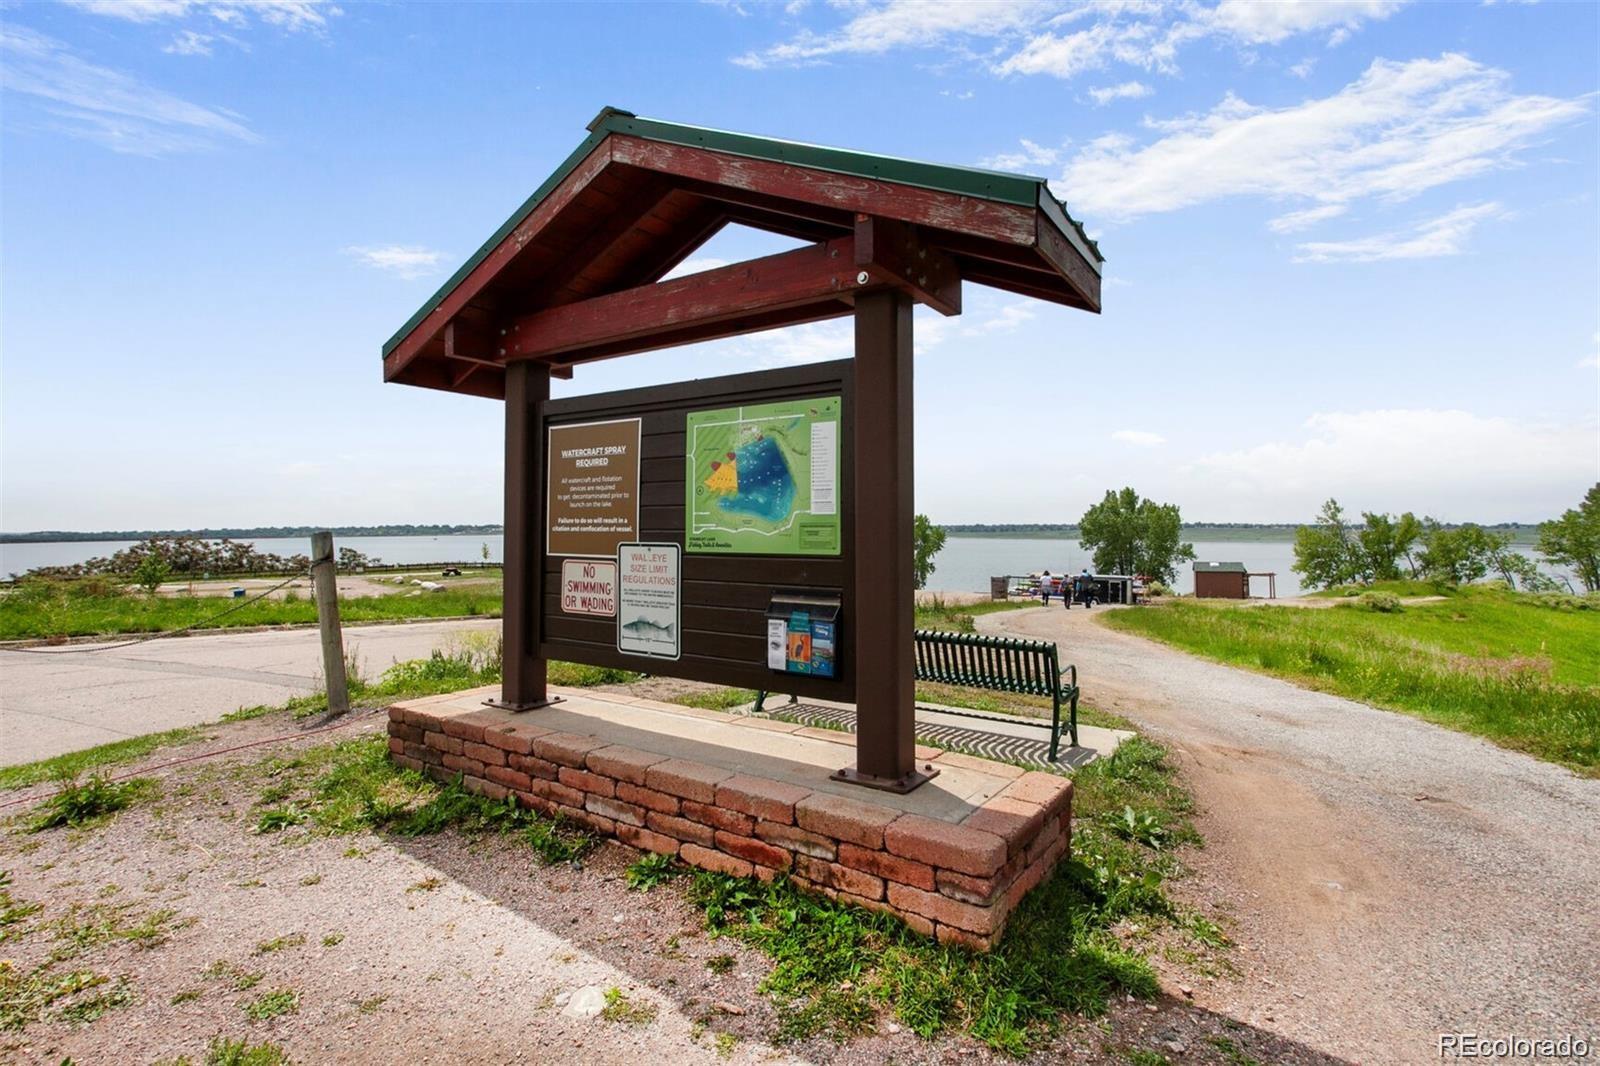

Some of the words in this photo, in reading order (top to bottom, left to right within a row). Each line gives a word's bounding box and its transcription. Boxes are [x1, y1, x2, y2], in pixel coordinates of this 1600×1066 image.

[561, 448, 604, 458] WATERCRAFT
[604, 445, 627, 456] SPRAY
[576, 458, 609, 468] REQUIRED
[583, 566, 596, 578] NO
[630, 564, 647, 574] SIZE
[649, 565, 668, 574] LIMIT
[623, 574, 676, 586] REGULATIONS
[568, 580, 611, 595] SWIMMING
[565, 596, 576, 608] OR
[580, 597, 614, 611] WADING
